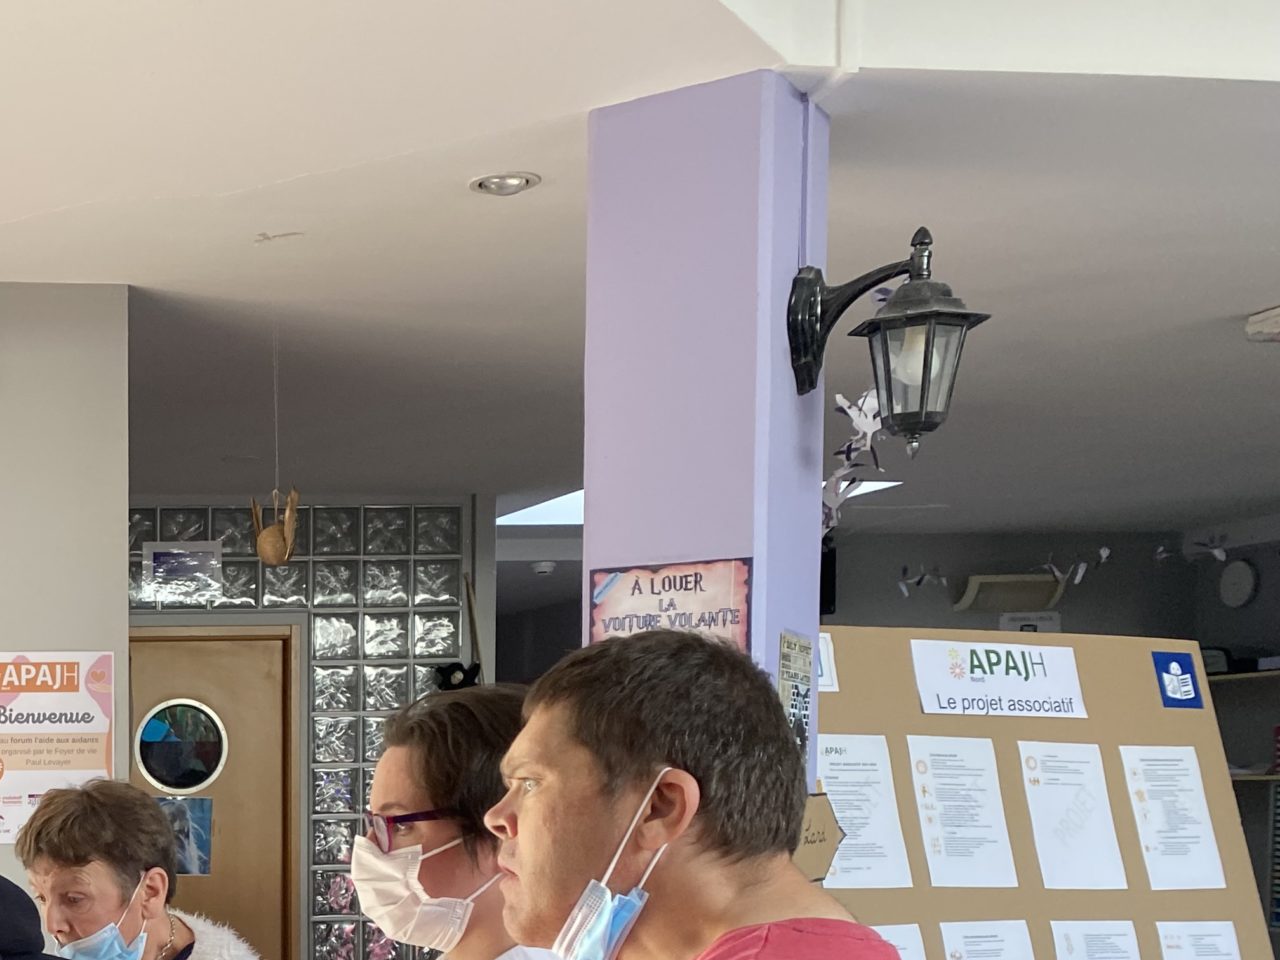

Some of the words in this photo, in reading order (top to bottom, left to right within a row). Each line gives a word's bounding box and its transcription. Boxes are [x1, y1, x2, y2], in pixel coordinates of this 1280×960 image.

[631, 575, 643, 596] À
[650, 572, 706, 595] LOUER
[658, 598, 678, 612] LA
[602, 613, 661, 633] VOITURE
[667, 608, 740, 630] VOLANTE
[2, 664, 78, 689] APAJH
[970, 649, 1047, 682] APAJH
[936, 693, 956, 709] Le
[962, 695, 1004, 715] projet
[1007, 697, 1074, 713] associatif
